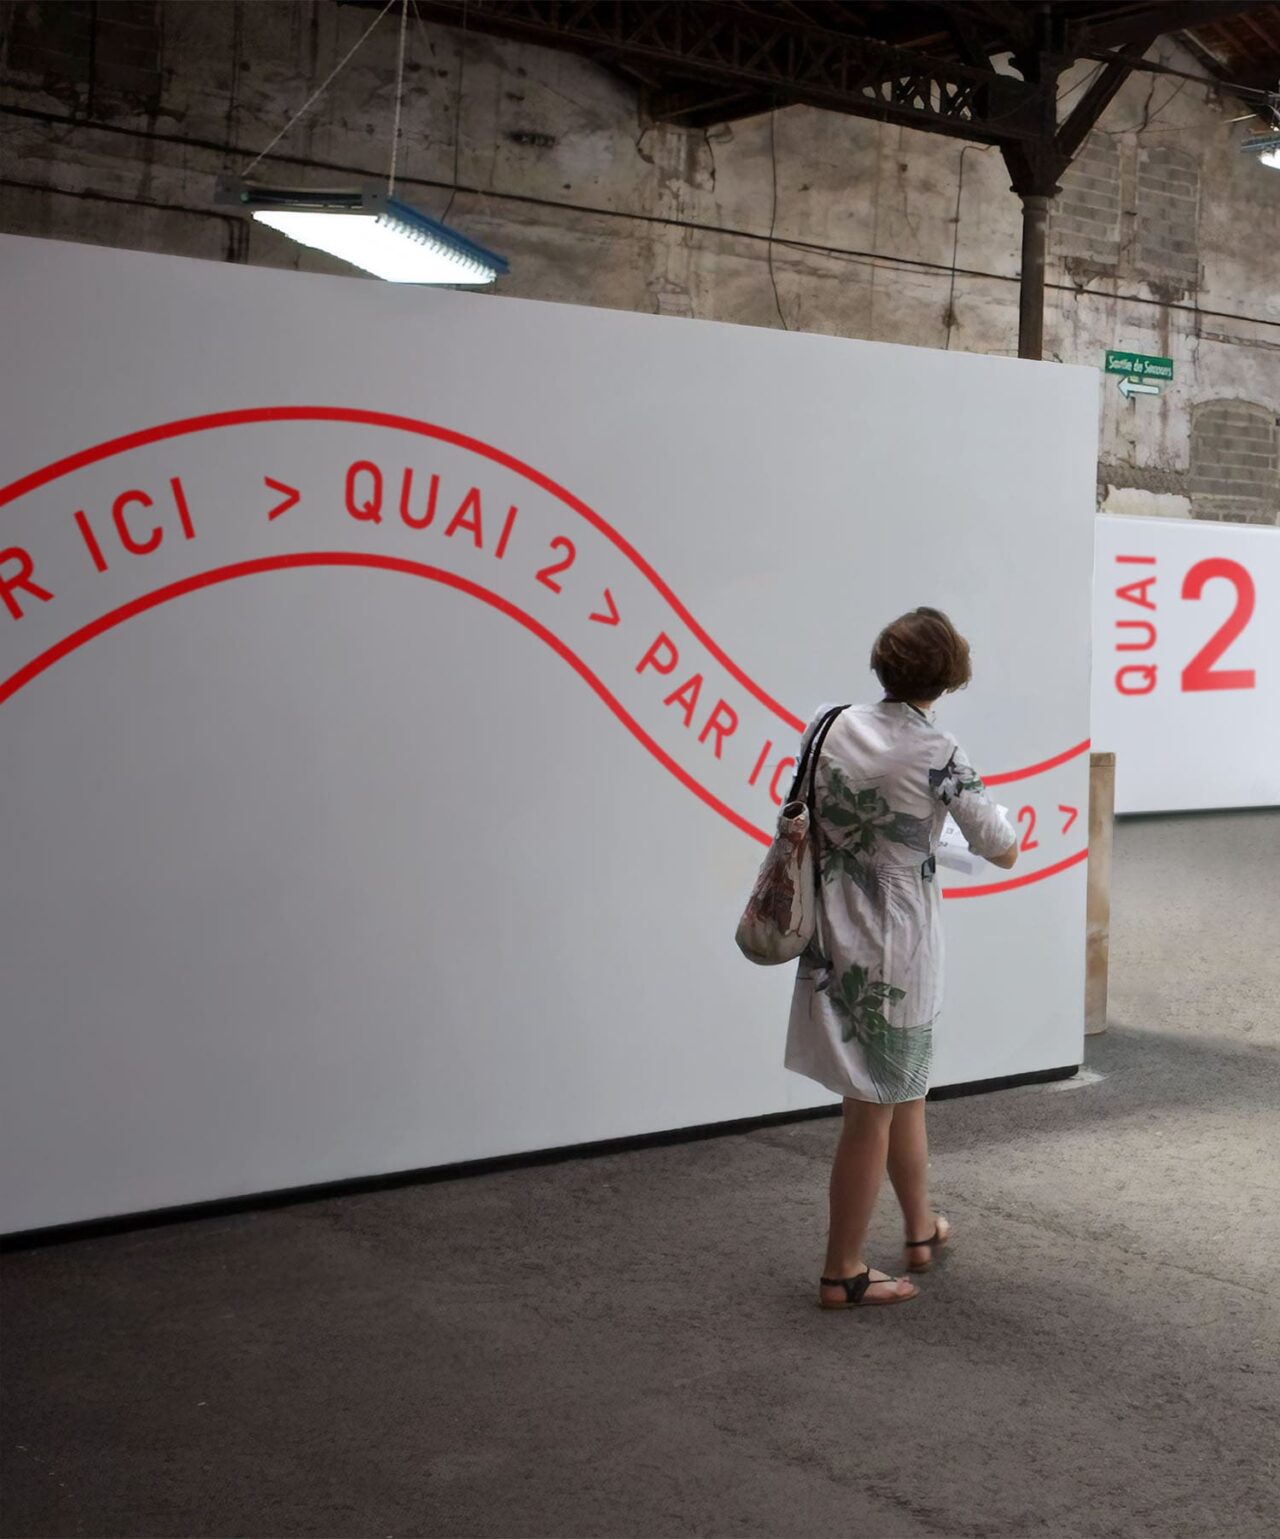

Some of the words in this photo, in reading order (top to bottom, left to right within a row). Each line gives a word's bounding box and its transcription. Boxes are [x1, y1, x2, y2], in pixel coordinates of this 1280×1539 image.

[74, 476, 196, 572] ICI
[344, 460, 518, 559] QUAI
[535, 536, 576, 594] 2
[636, 632, 739, 759] PAR
[1017, 806, 1038, 852] 2
[1115, 555, 1157, 696] QUAI
[1180, 557, 1255, 692] 2
